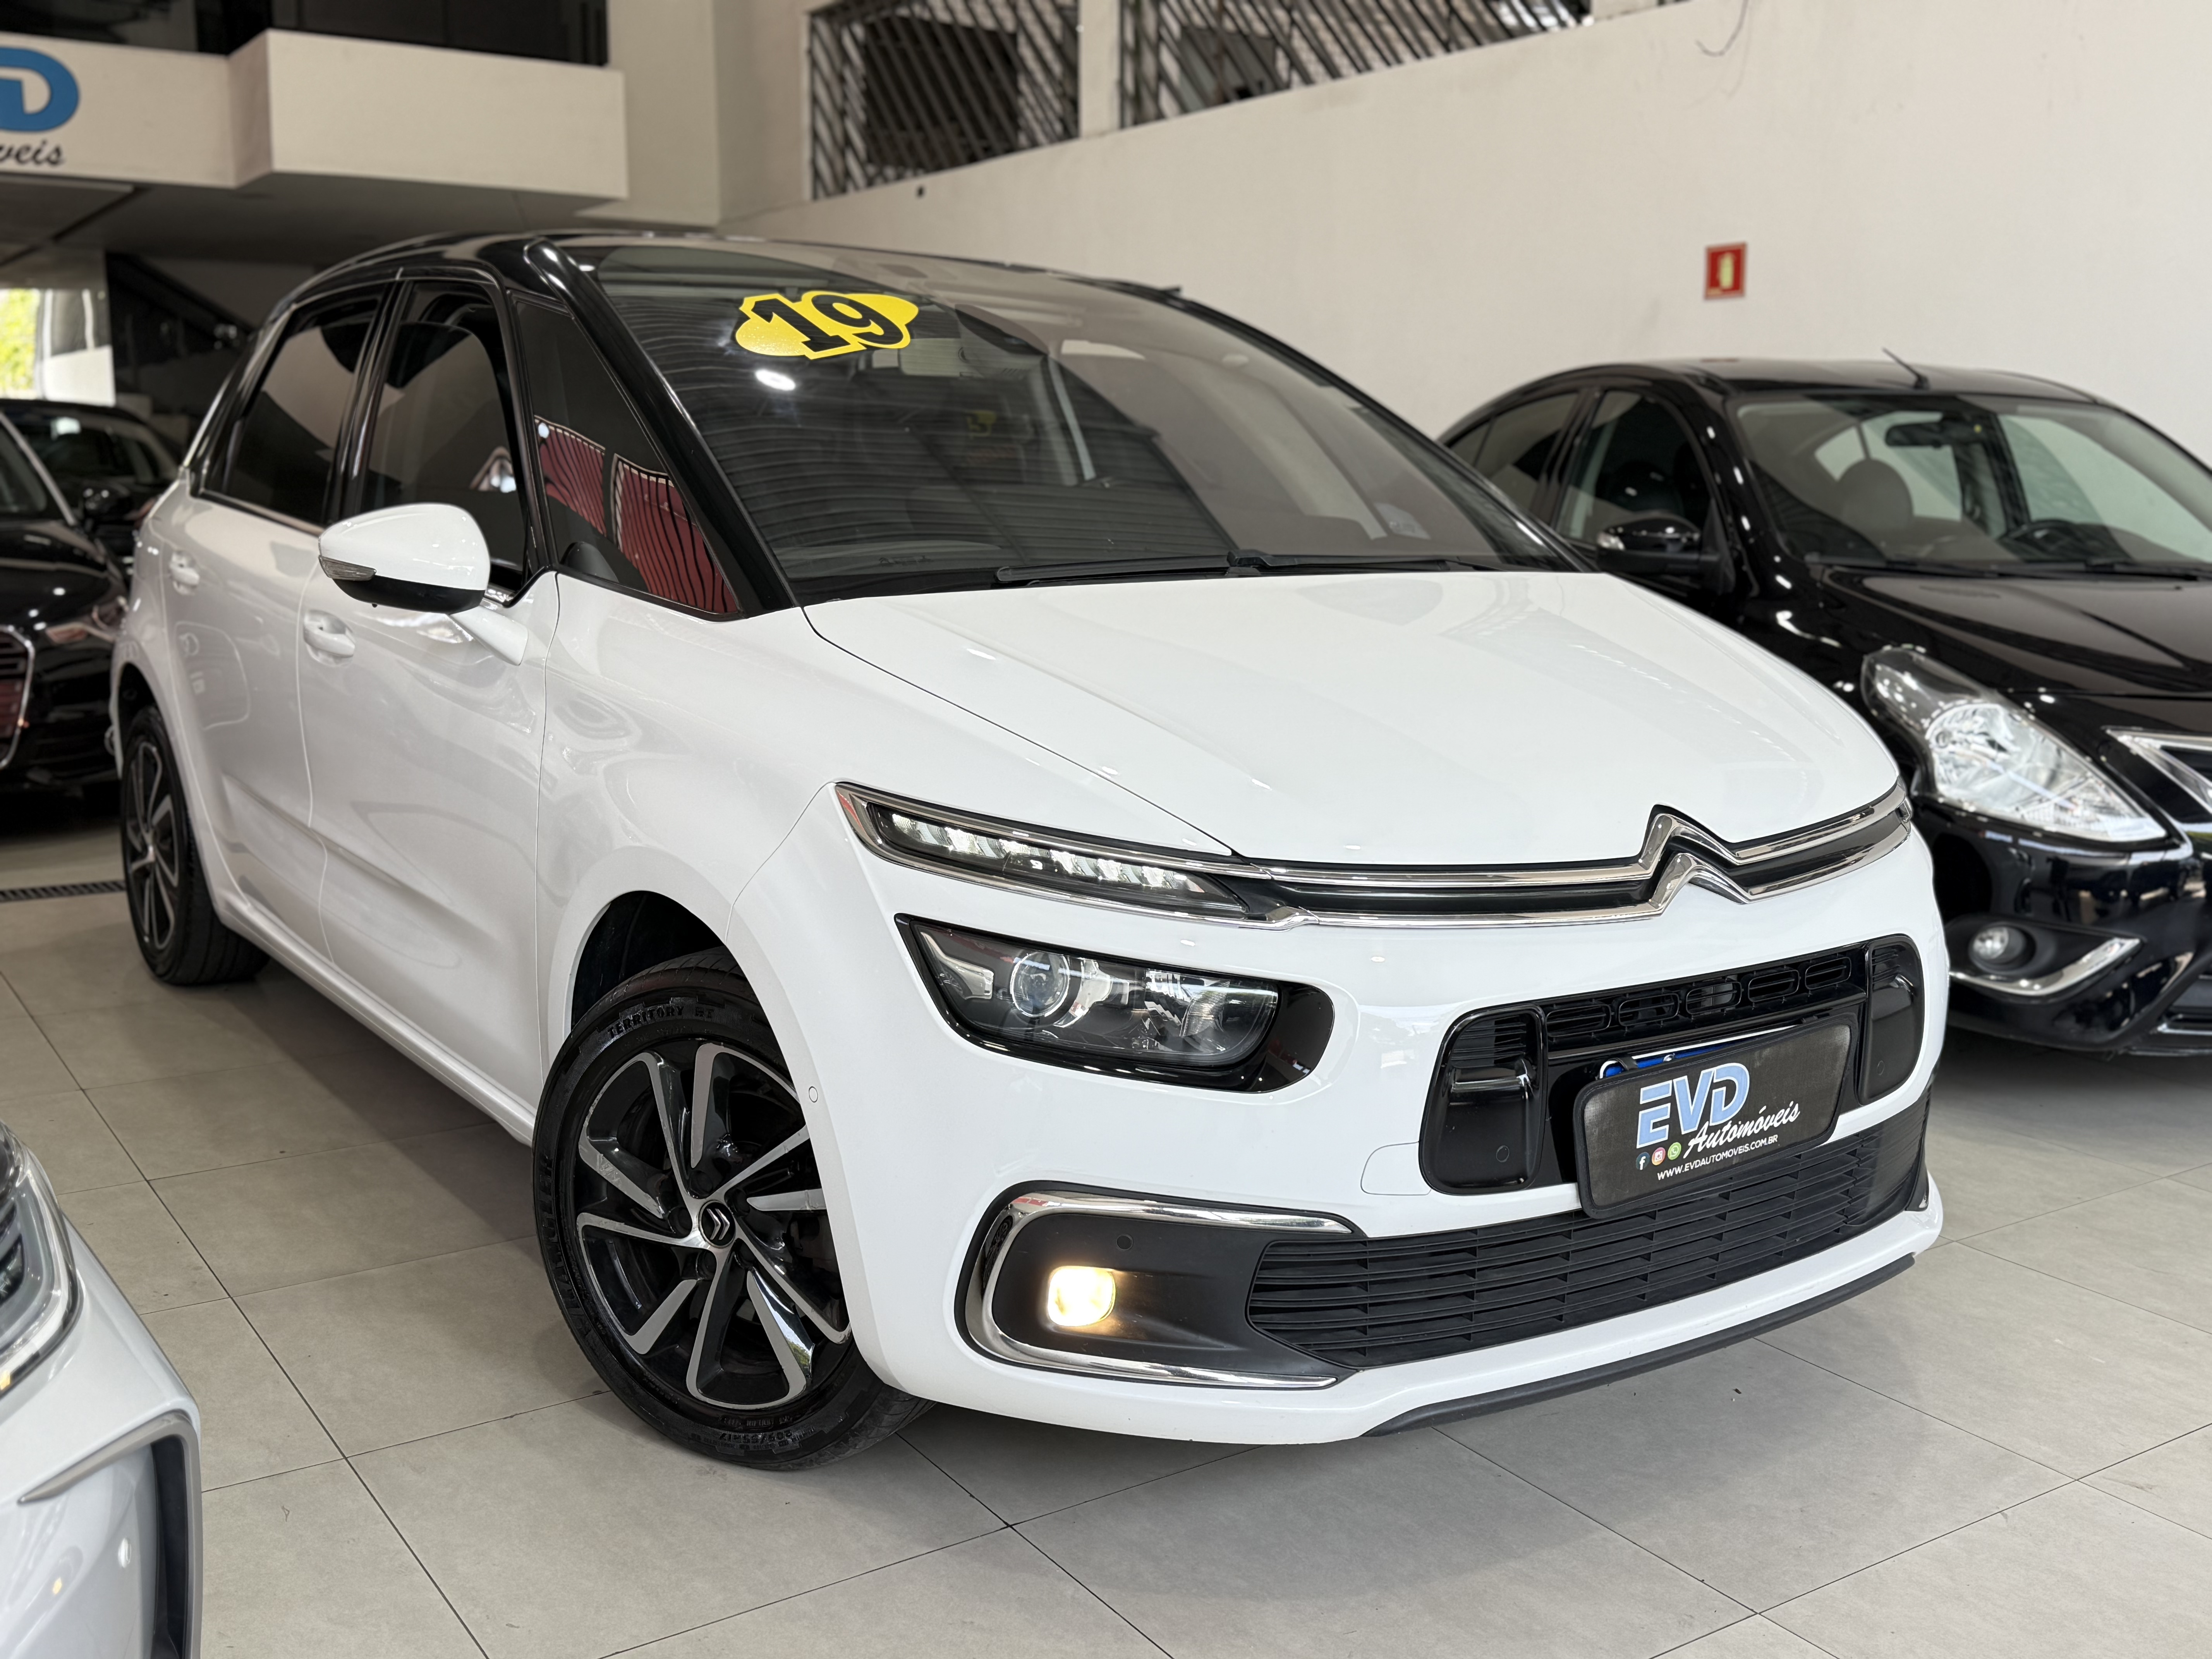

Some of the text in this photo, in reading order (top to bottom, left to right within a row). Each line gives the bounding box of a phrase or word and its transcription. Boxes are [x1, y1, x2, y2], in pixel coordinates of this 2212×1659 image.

[750, 295, 904, 353] 19
[607, 1006, 684, 1038] TERRITORY
[1637, 1062, 1750, 1149] EVD
[1683, 1101, 1801, 1159] Automóveis
[1657, 1134, 1778, 1180] WWW.EVDAUTOMOVEIS.COM.BR
